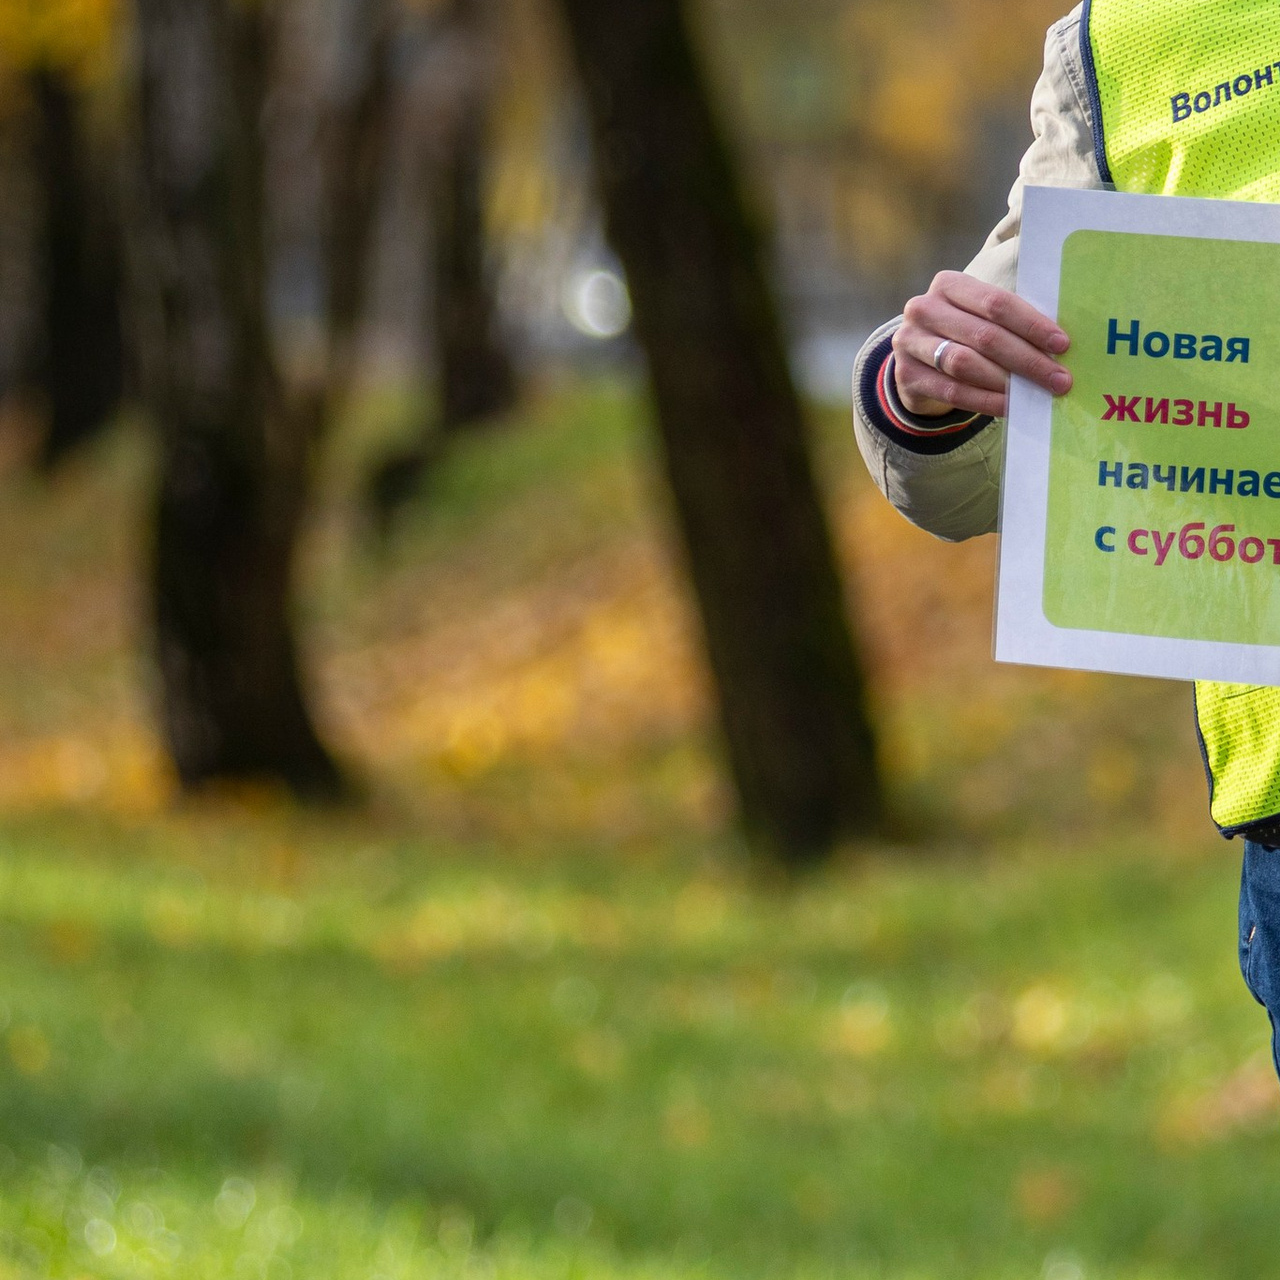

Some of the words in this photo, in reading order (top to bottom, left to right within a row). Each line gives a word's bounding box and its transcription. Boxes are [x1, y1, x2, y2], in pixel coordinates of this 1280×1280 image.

[1105, 318, 1251, 364] Новая
[1100, 393, 1251, 430] жизнь
[1094, 525, 1116, 554] с
